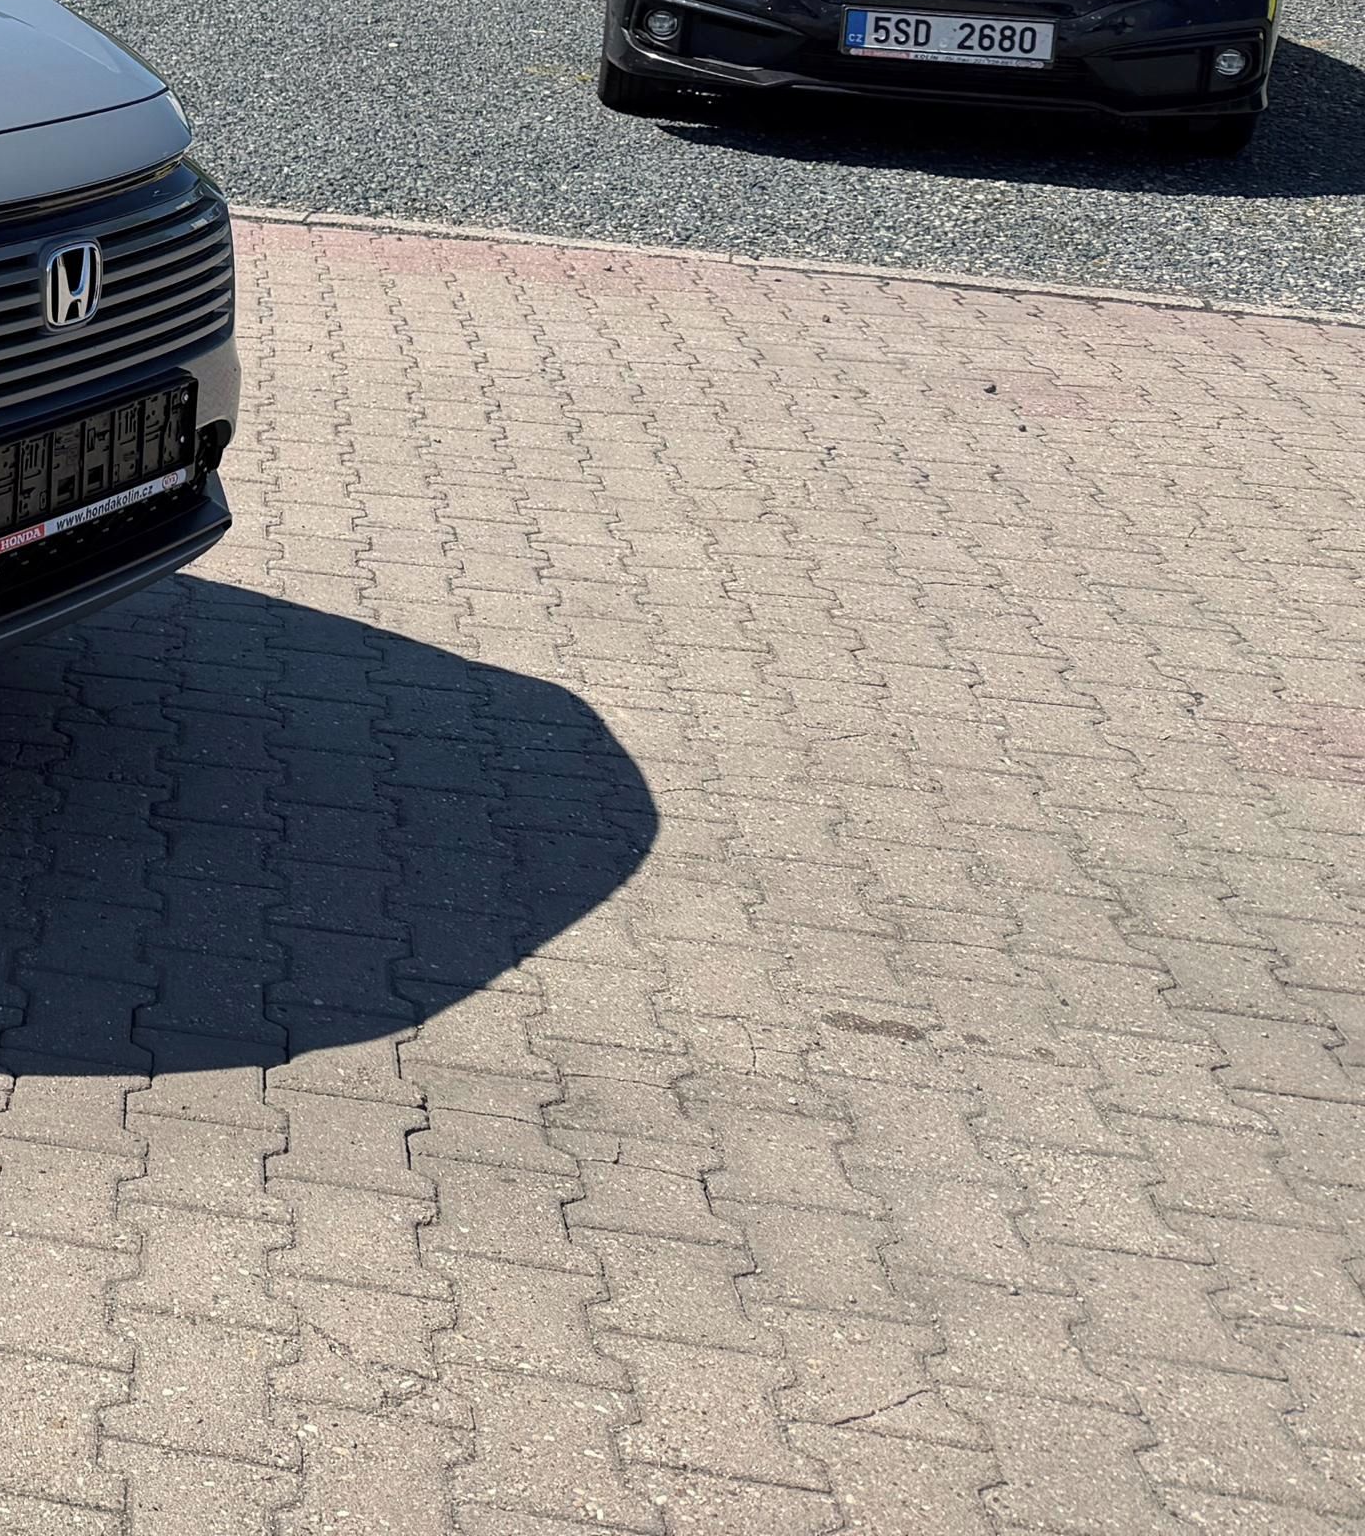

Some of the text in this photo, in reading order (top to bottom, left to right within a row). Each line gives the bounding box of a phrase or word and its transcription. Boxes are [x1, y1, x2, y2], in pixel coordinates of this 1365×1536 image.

[848, 34, 863, 43] CZ
[873, 16, 1037, 54] 5SD 2680
[0, 484, 154, 551] HONDA www.hondakolin.cz
